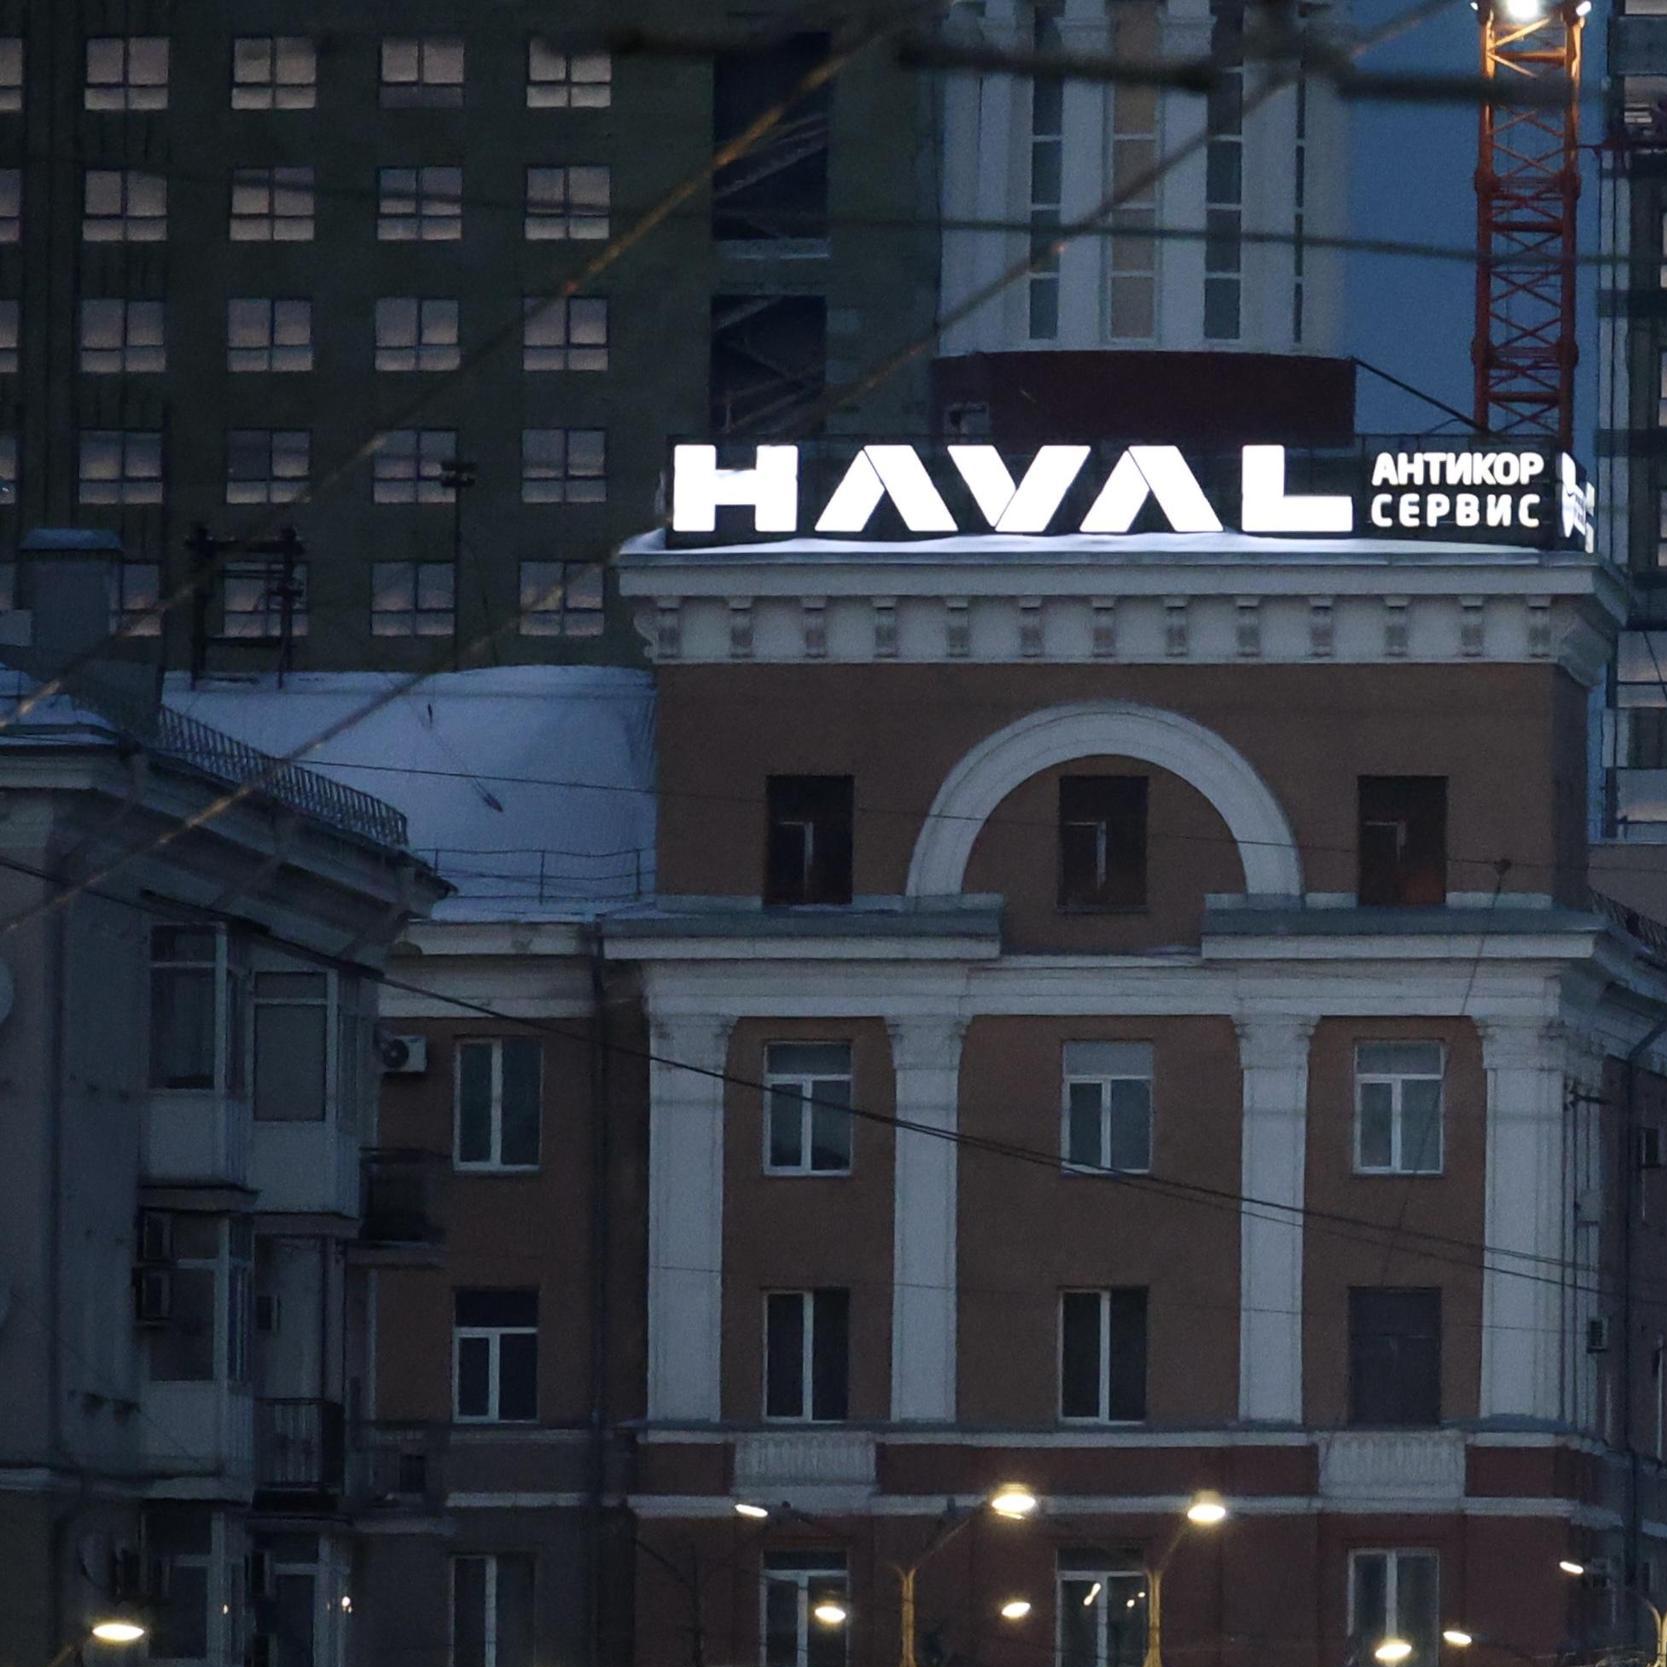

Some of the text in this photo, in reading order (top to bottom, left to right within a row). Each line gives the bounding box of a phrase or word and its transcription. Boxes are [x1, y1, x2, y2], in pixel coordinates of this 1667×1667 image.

[1370, 452, 1544, 486] АНТИКОР
[672, 444, 1354, 533] HAVAL
[1370, 493, 1543, 529] СЕРВИС
